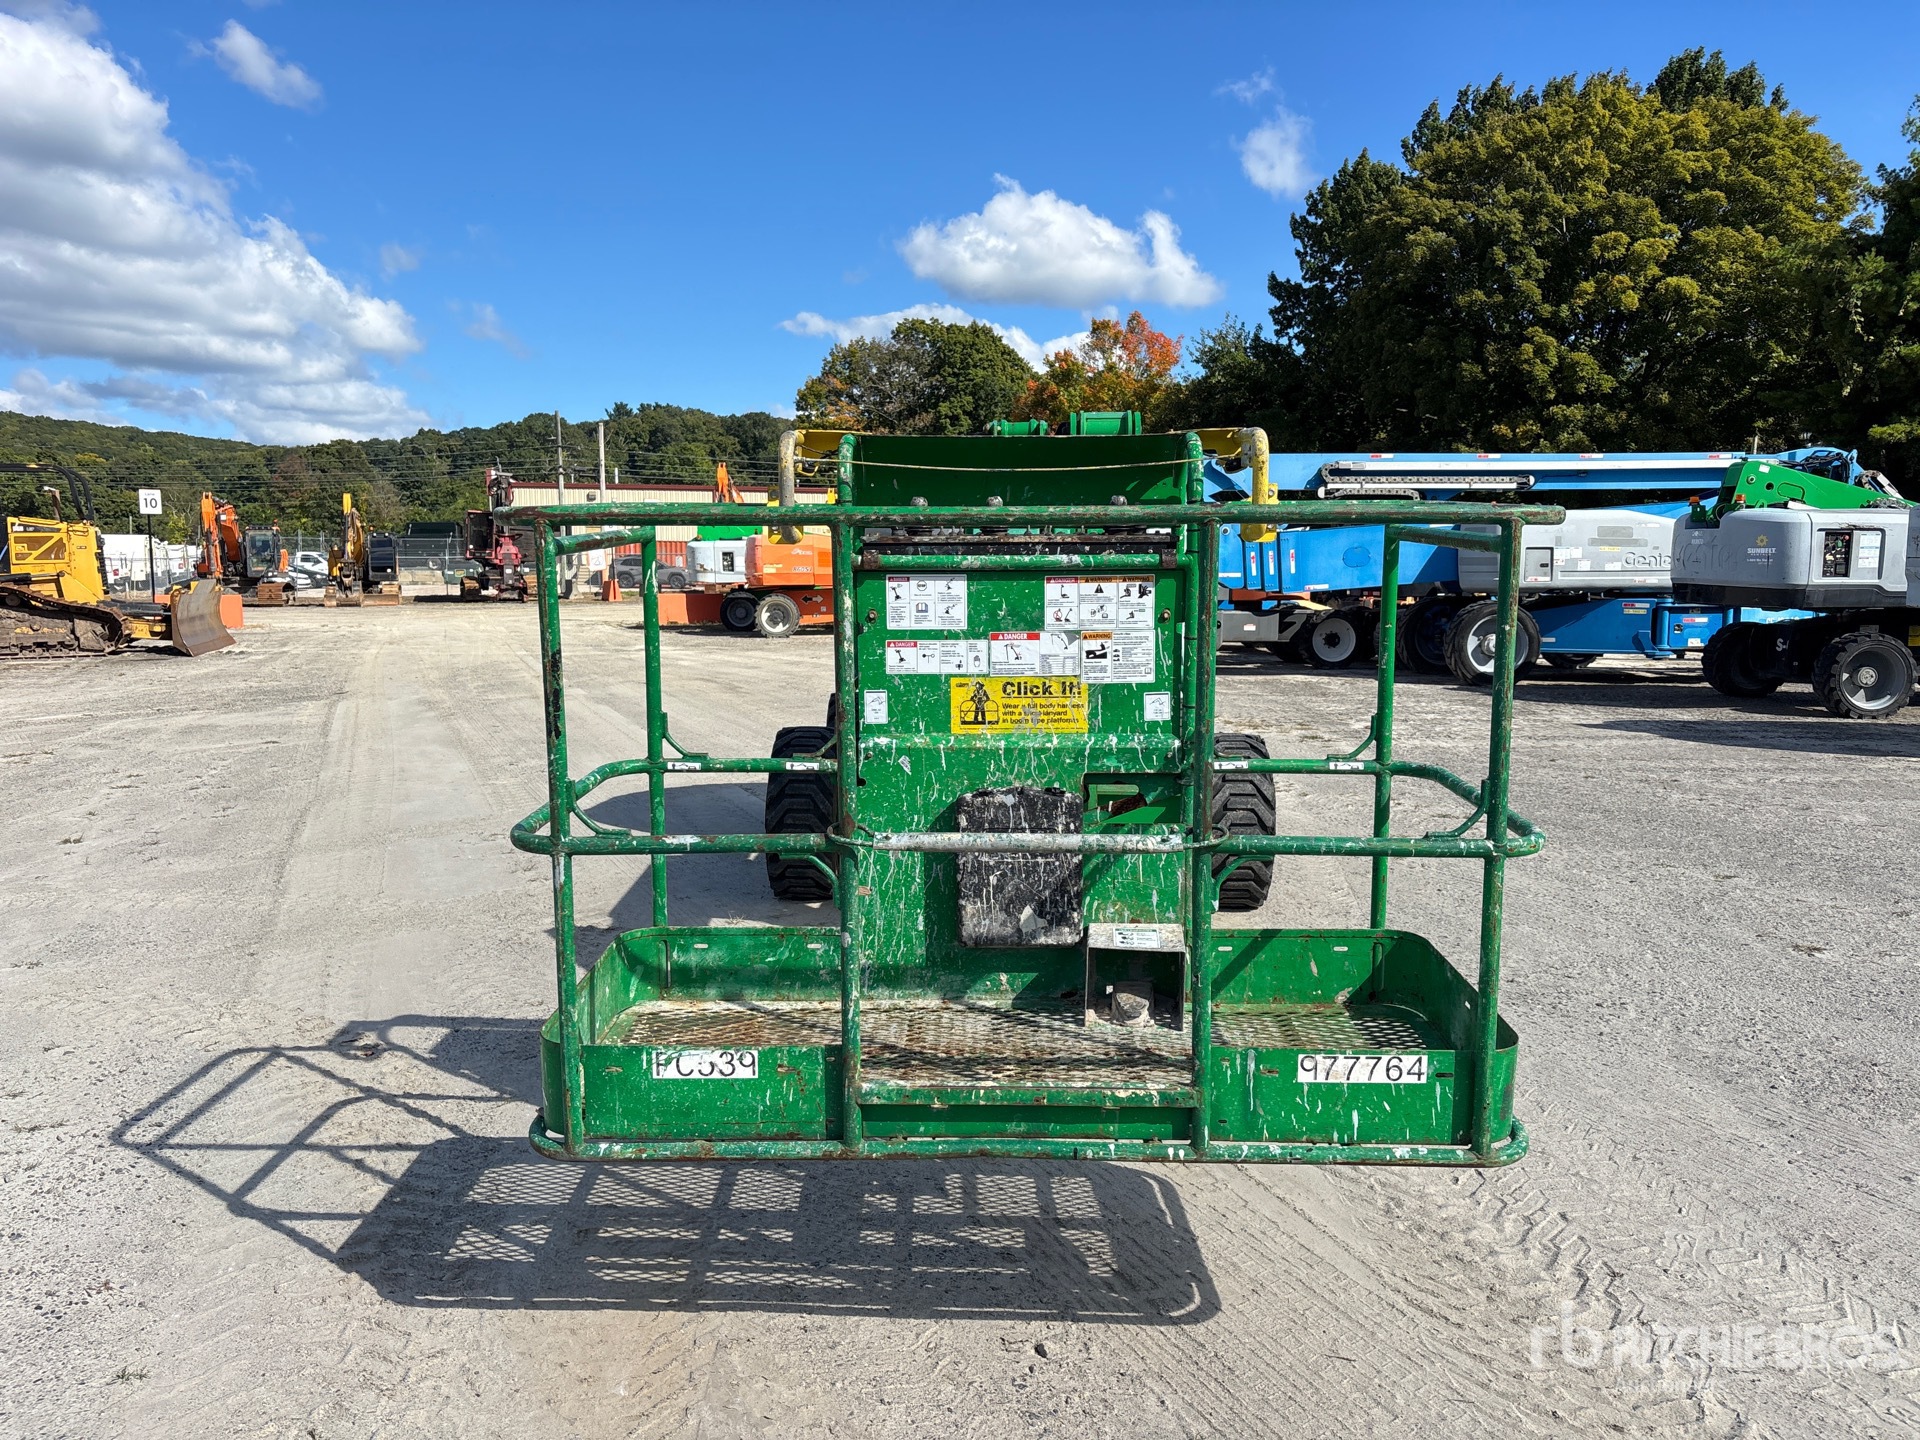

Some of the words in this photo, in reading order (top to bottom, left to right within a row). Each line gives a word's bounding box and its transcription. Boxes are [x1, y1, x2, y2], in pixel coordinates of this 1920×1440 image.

[144, 498, 157, 508] 10
[1624, 552, 1672, 567] Genie
[1776, 638, 1789, 651] S-
[1002, 682, 1053, 695] Click
[1061, 681, 1082, 695] It!
[1300, 1055, 1425, 1081] 977764
